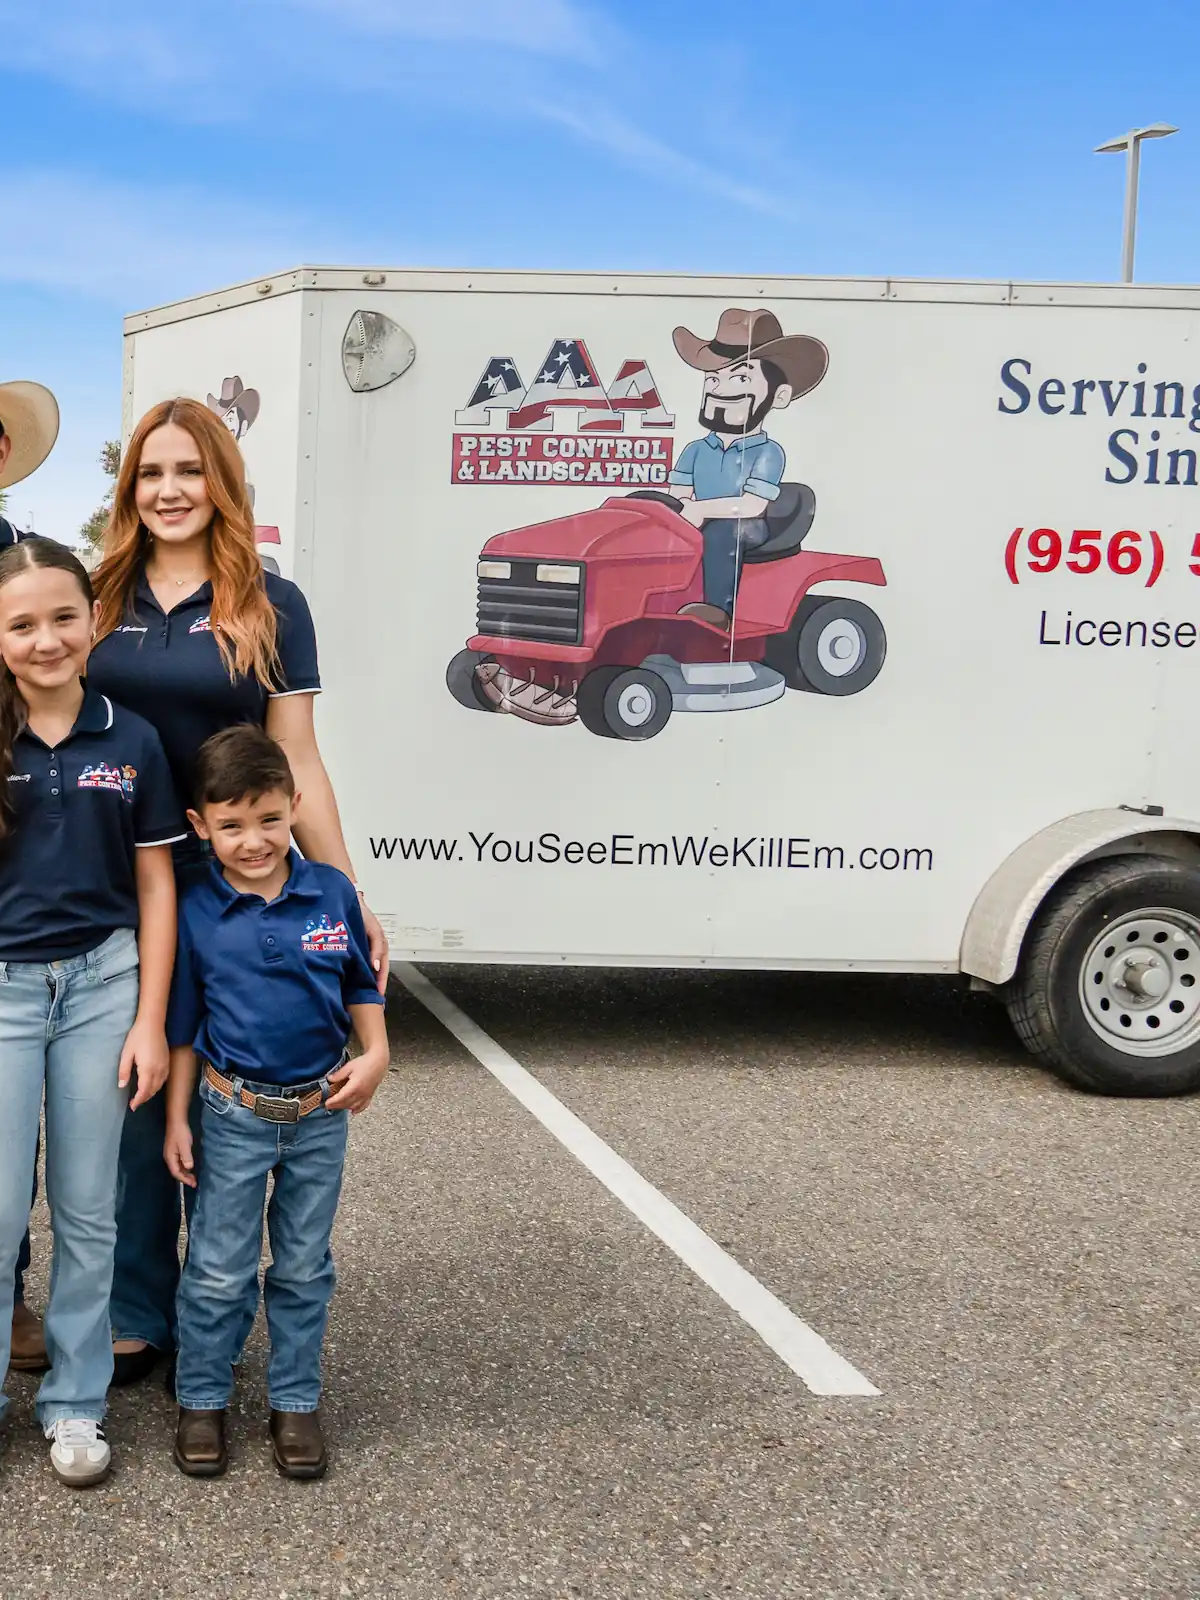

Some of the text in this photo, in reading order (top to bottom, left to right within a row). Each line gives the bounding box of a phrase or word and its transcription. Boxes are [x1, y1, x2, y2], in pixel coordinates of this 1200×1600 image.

[454, 337, 676, 432] AAA
[460, 436, 667, 460] PEST CONTROL
[1004, 527, 1165, 588] (956)
[1039, 610, 1200, 649] License
[369, 832, 934, 871] www.YouSeeEmWeKillEm.com
[303, 943, 320, 951] PEST
